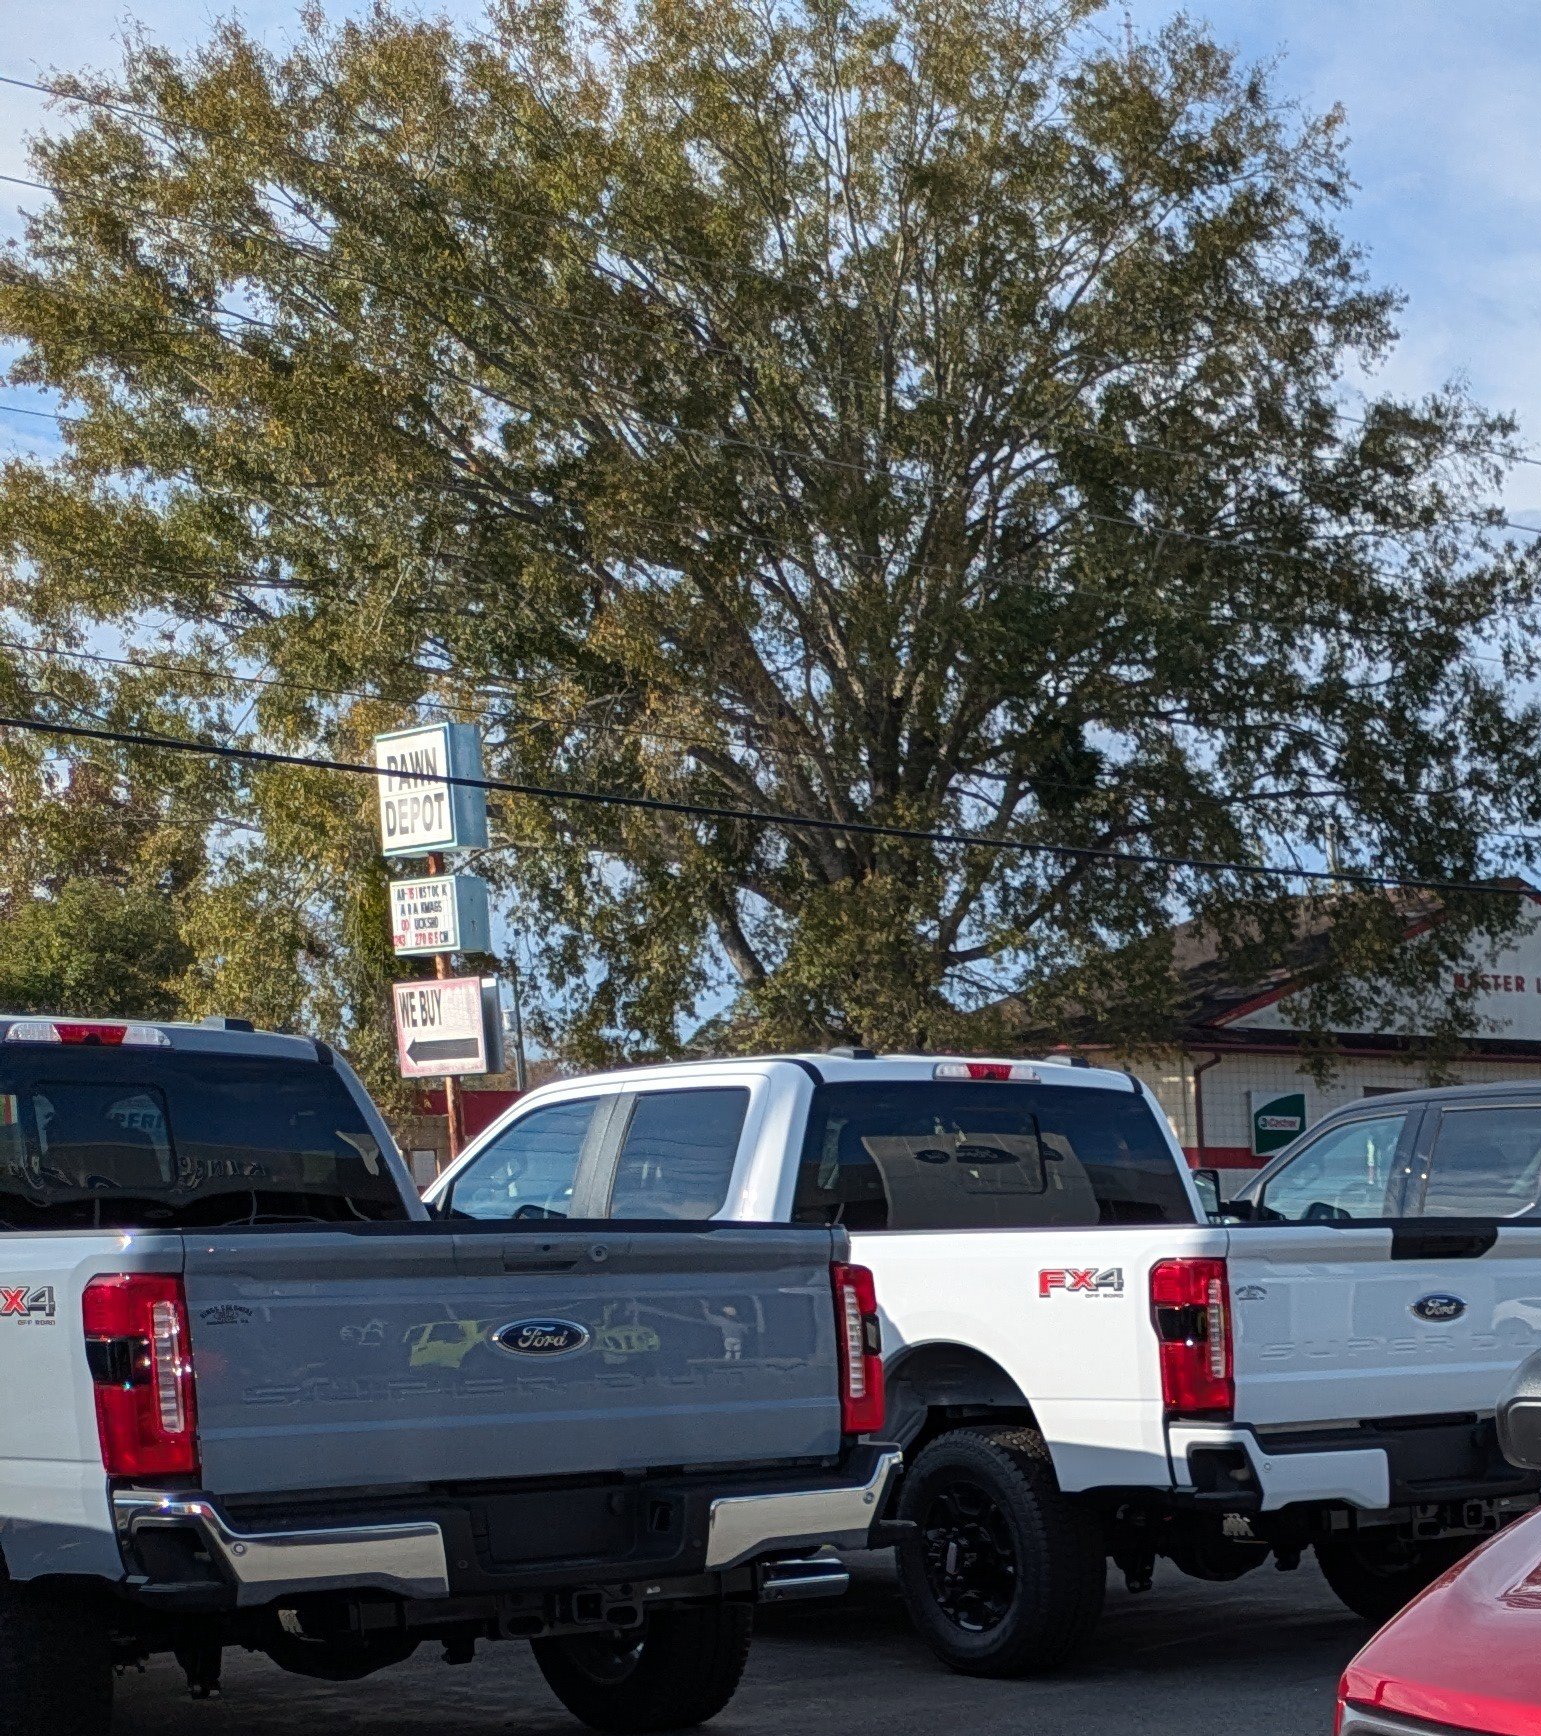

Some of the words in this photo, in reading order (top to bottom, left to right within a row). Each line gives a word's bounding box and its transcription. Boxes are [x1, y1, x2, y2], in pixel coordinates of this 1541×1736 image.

[386, 747, 440, 792] PAWN
[385, 792, 445, 837] DEPOT
[1453, 972, 1526, 993] MSTER
[399, 992, 418, 1028] WE
[418, 989, 442, 1027] BUY
[1038, 1267, 1124, 1298] FX4
[1424, 1298, 1457, 1316] Ford
[517, 1325, 569, 1348] Ford
[1258, 1334, 1456, 1359] SUPER
